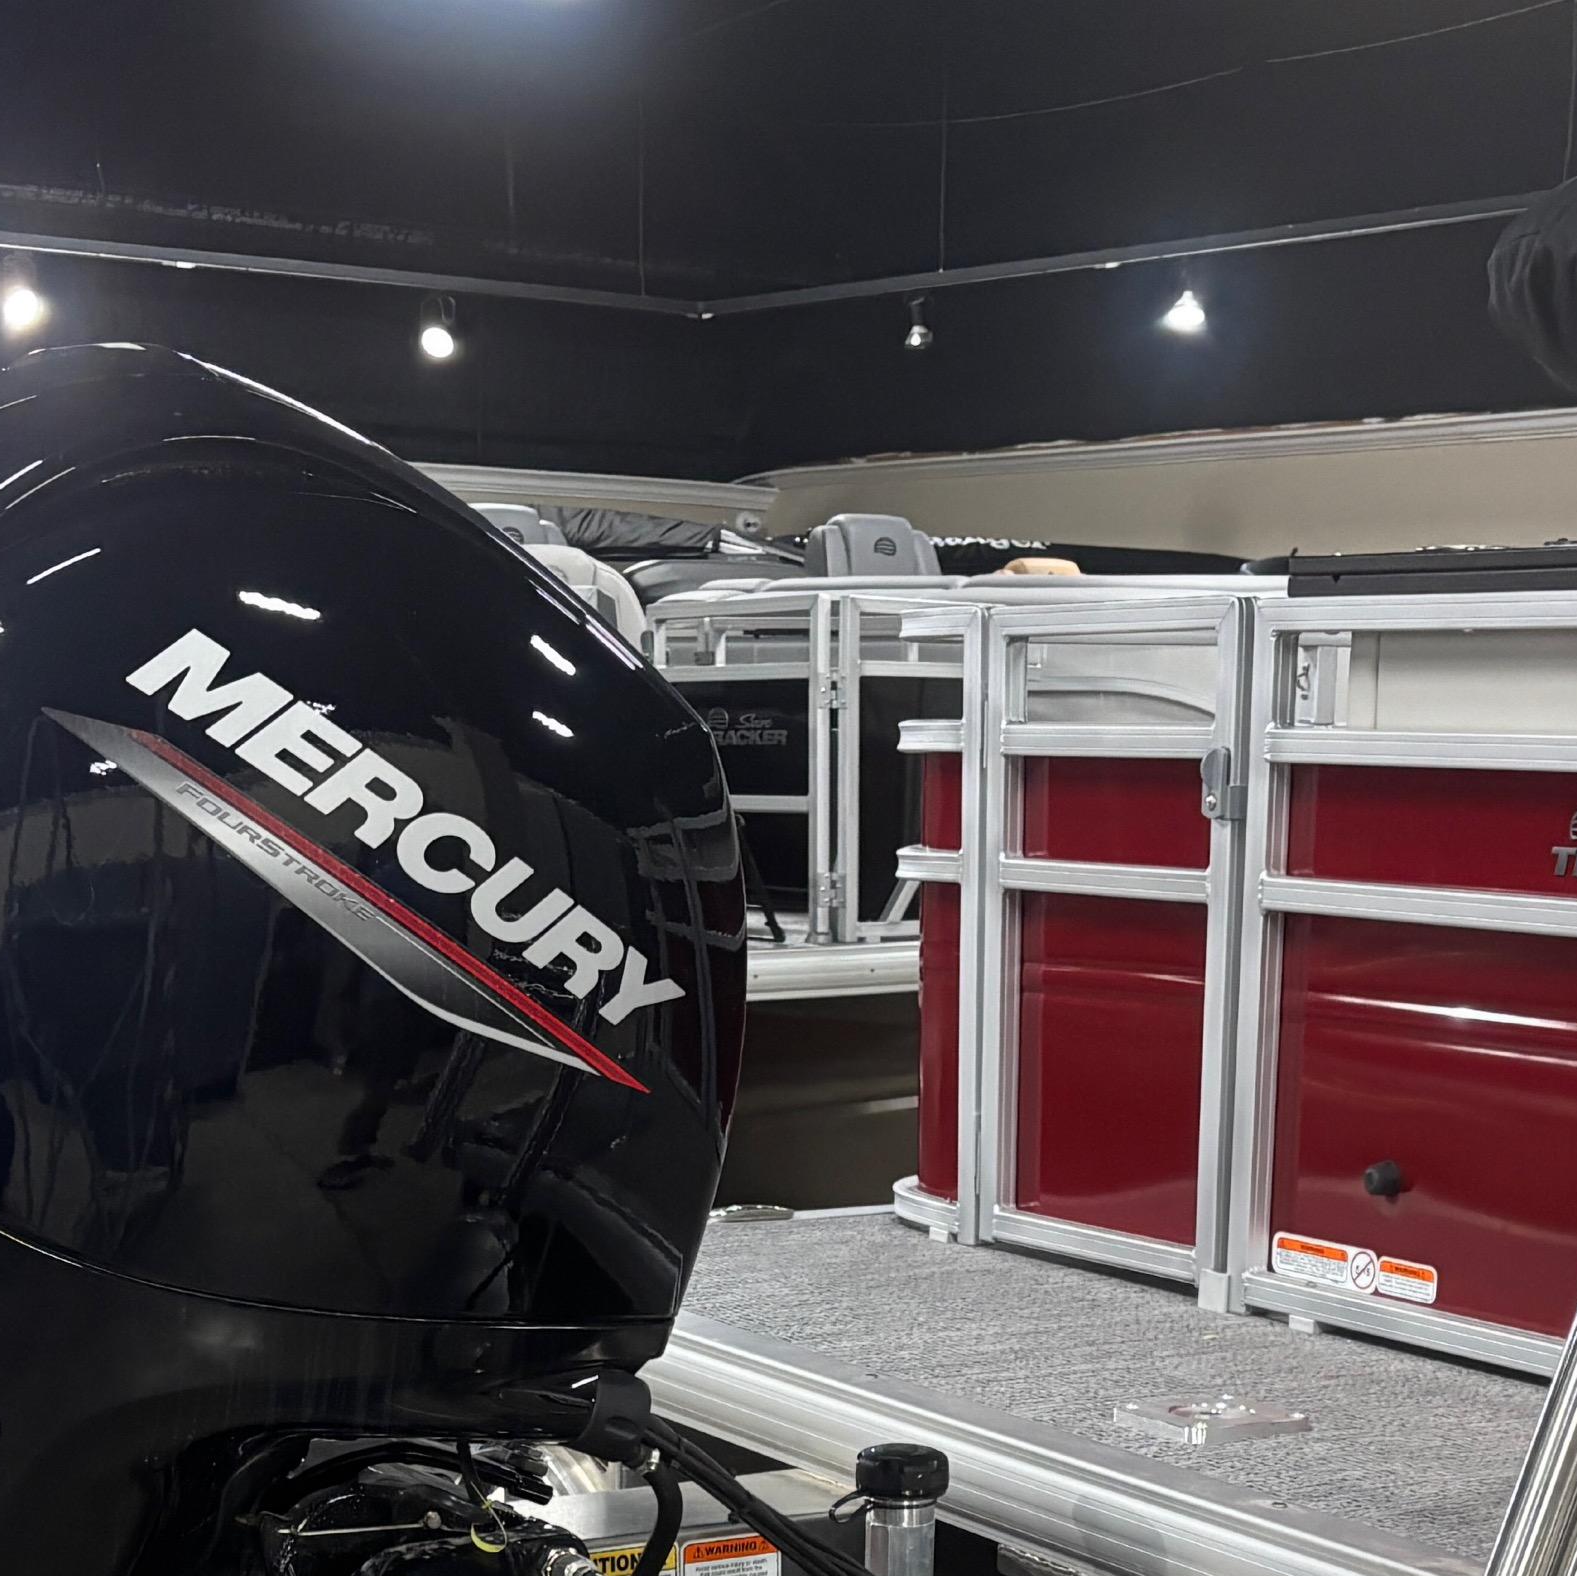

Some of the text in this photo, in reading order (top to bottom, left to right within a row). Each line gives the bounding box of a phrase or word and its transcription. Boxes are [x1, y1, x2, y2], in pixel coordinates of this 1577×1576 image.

[713, 729, 788, 746] RACKER
[126, 629, 685, 1025] MERCURY
[176, 784, 377, 921] FOURSTROKE
[705, 1541, 757, 1556] WARNING
